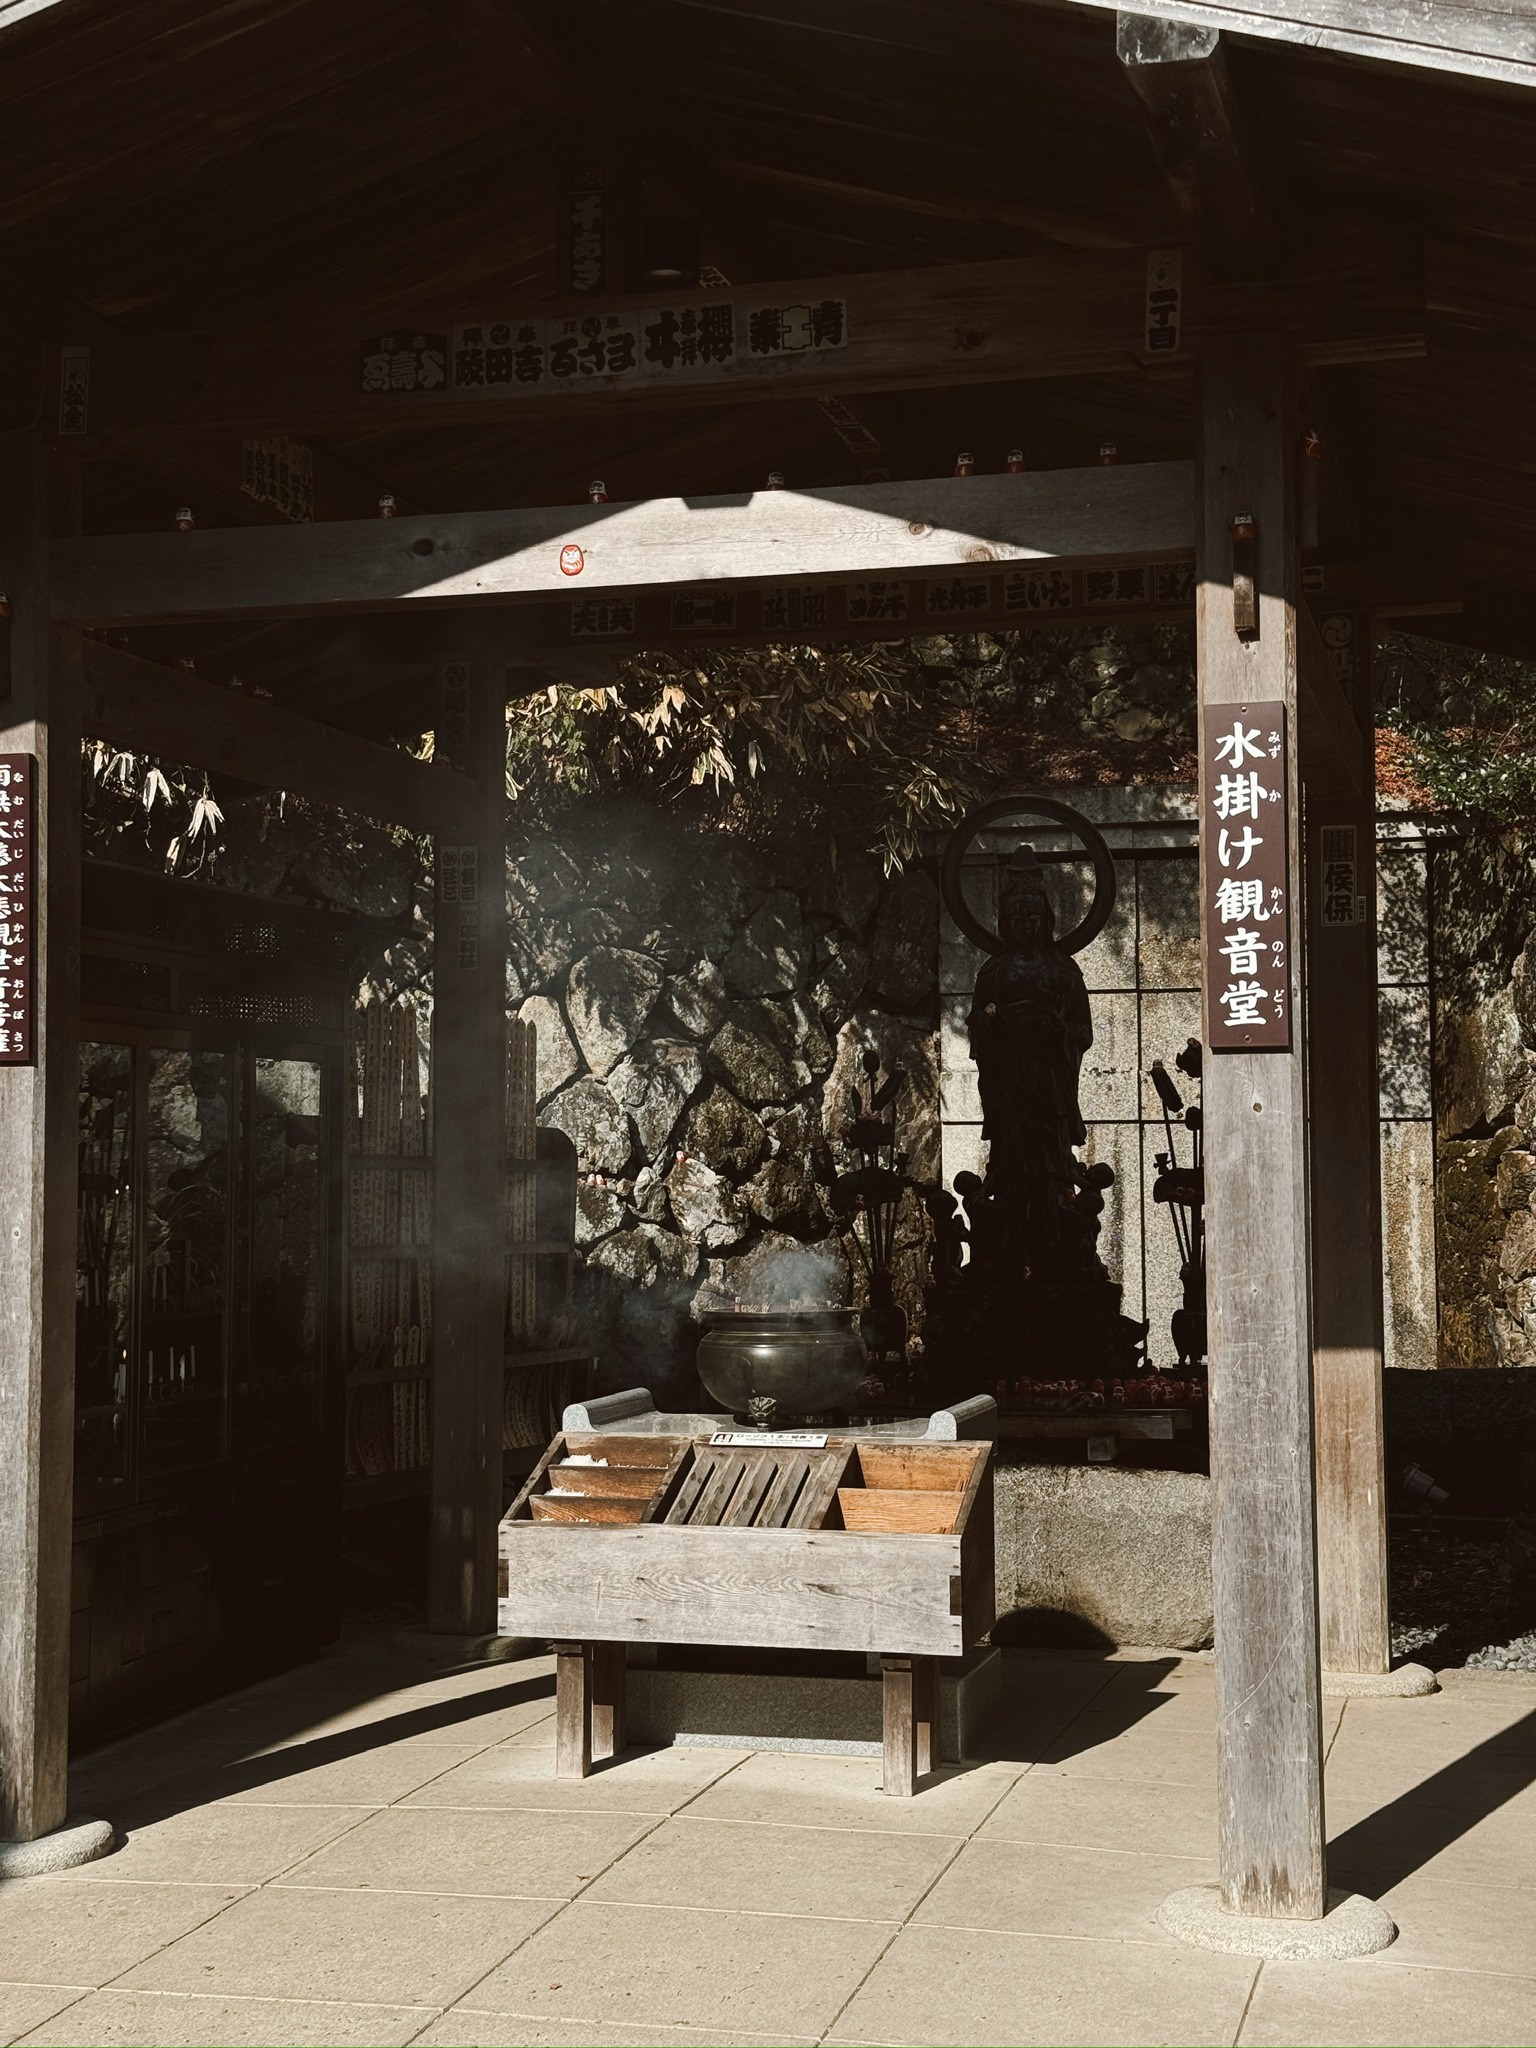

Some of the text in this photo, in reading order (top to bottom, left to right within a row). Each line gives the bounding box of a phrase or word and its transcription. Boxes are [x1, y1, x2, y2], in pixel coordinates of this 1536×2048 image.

[1213, 721, 1271, 1027] 水掛け観音堂
